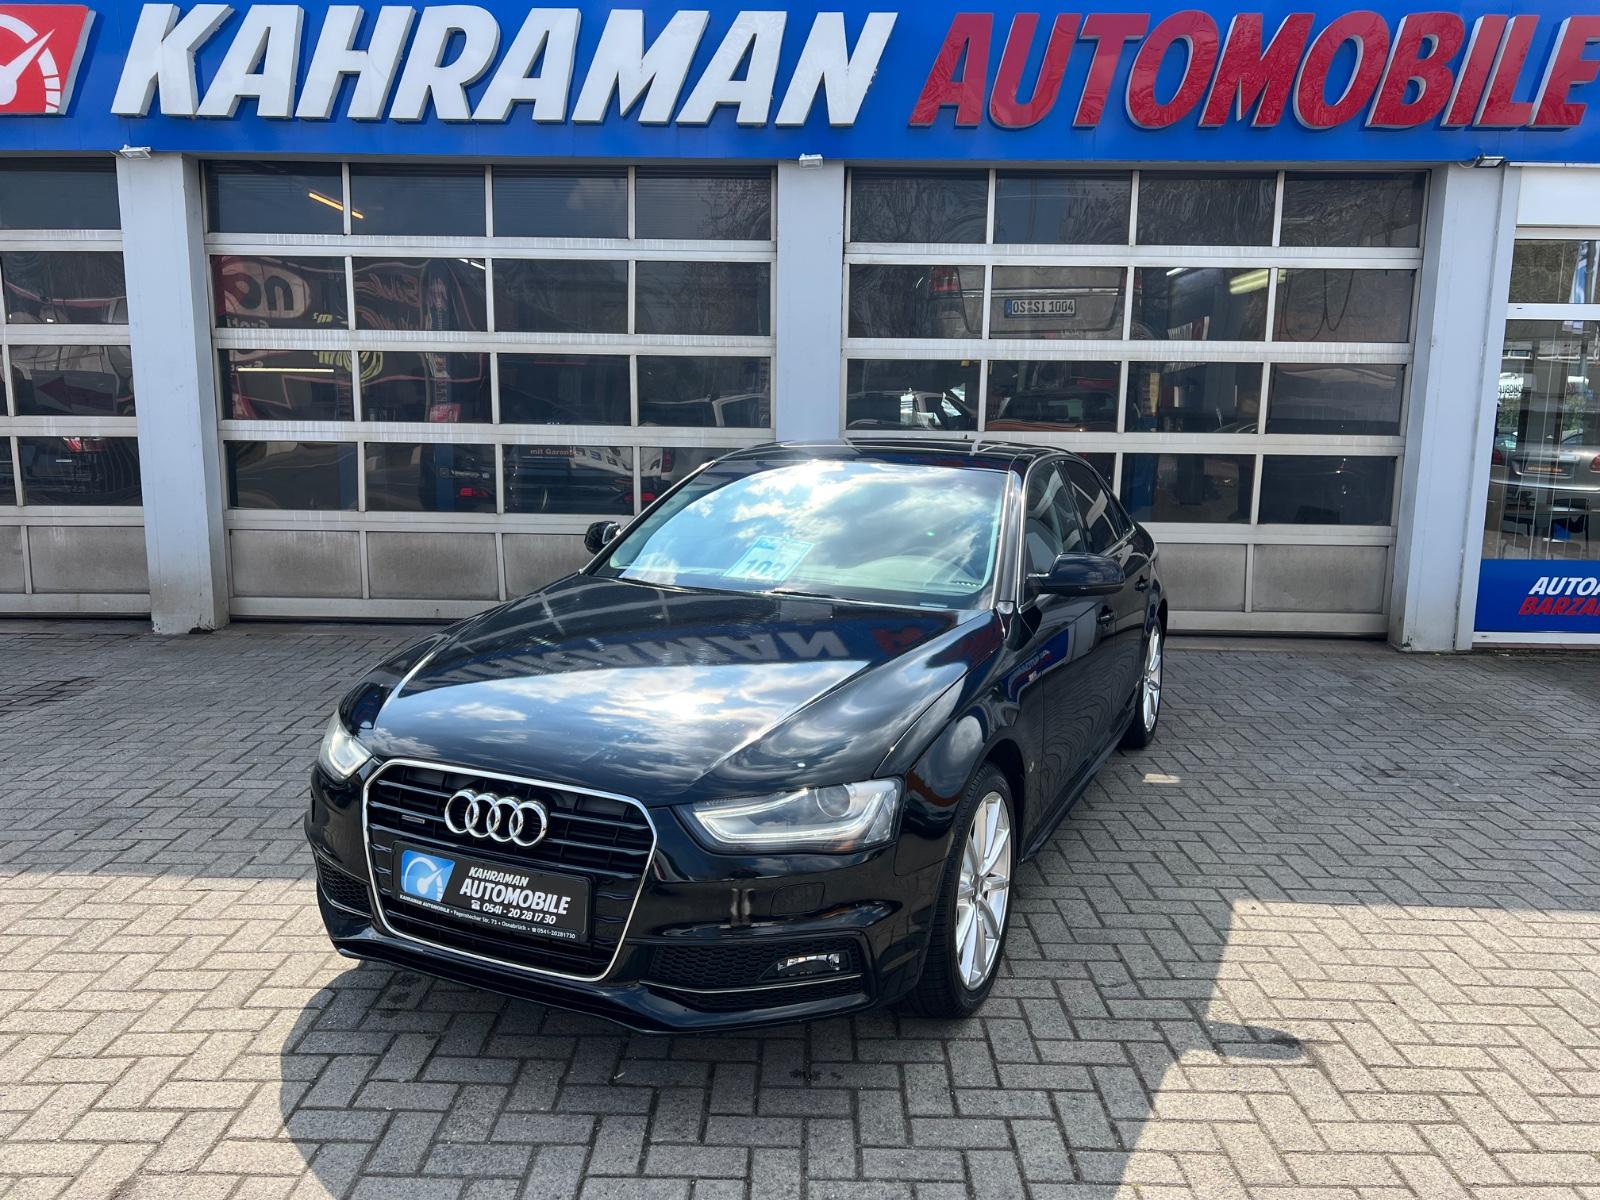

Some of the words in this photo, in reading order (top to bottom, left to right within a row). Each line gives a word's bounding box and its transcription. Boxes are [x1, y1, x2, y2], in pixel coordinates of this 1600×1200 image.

[110, 3, 898, 127] KAHRAMAN
[908, 10, 1600, 129] AUTOMOBILE
[1013, 301, 1026, 313] OS
[1033, 301, 1045, 313] SI
[1049, 301, 1073, 312] 1004
[530, 447, 543, 455] mit
[468, 866, 530, 888] KAHRAMAN
[459, 878, 571, 915] AUTOMOBILE
[483, 902, 503, 915] 0541
[508, 907, 521, 918] 20
[521, 910, 533, 921] 28
[534, 912, 544, 922] 17
[543, 914, 557, 925] 30
